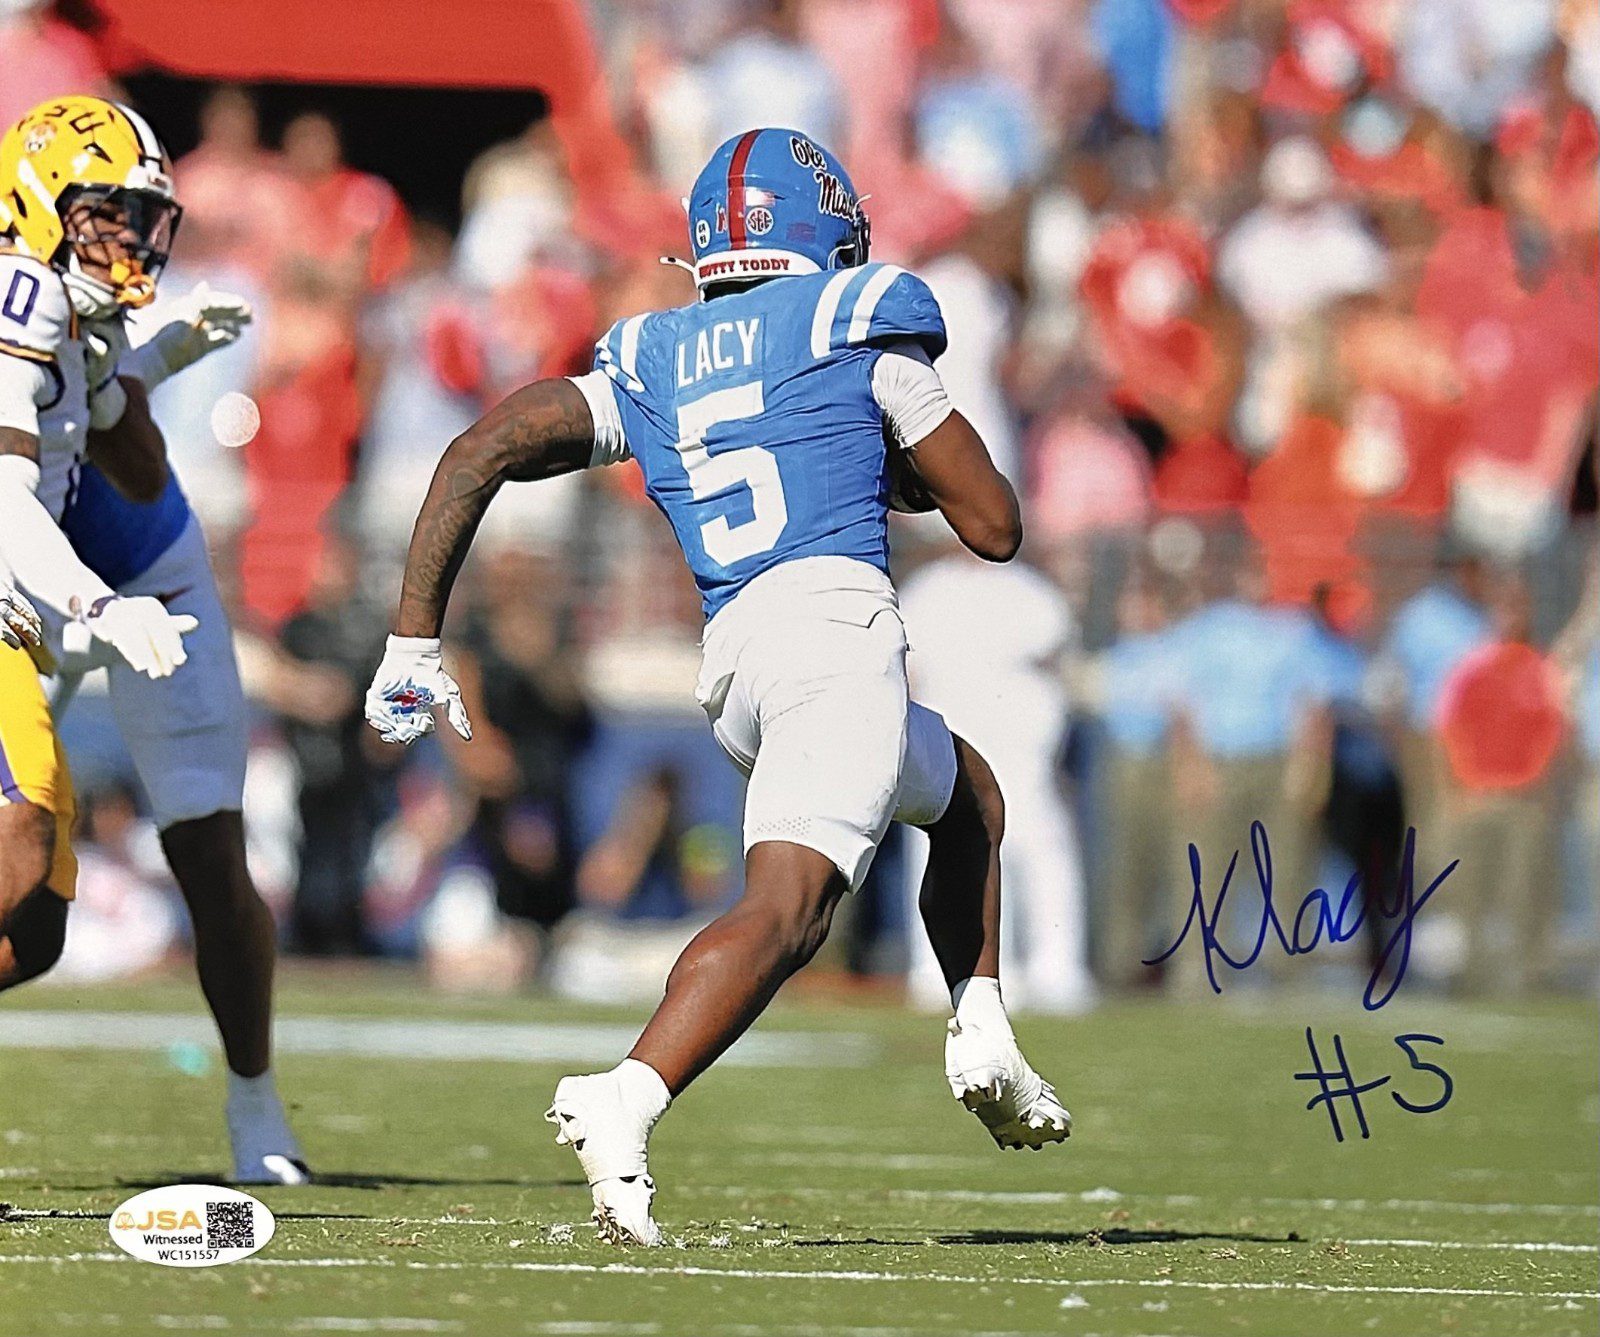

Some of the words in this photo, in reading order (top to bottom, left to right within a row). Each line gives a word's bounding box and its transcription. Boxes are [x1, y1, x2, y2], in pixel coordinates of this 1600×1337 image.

[790, 136, 827, 171] Ole
[699, 260, 735, 279] TTY
[740, 258, 790, 272] TODDY
[677, 318, 761, 387] LACY
[675, 381, 789, 568] 5
[1294, 1026, 1453, 1142] #5
[136, 1210, 203, 1231] JSA
[143, 1234, 203, 1245] Witnessed
[158, 1250, 220, 1261] WC151557
